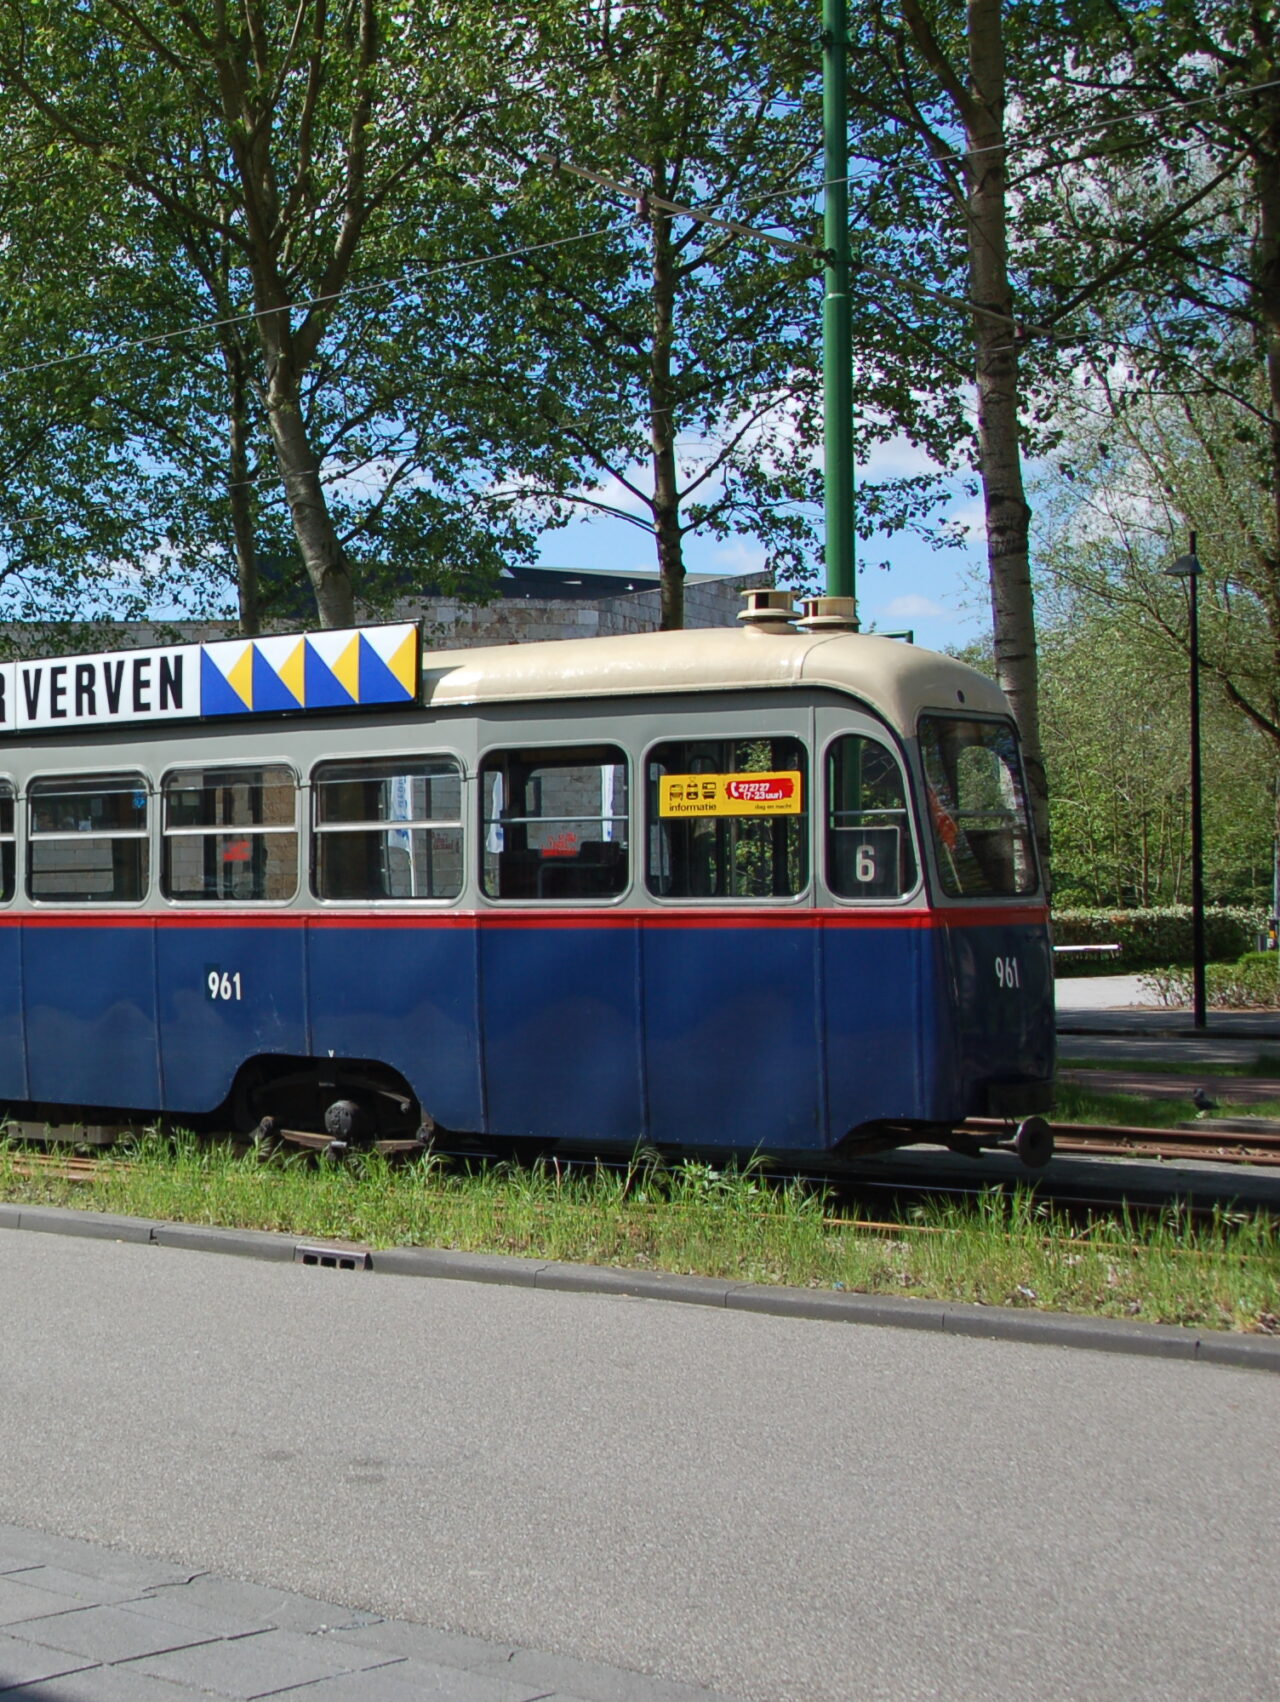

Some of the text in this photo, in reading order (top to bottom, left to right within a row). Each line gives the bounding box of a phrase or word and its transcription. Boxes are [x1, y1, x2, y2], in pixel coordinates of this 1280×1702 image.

[23, 654, 184, 720] VERVEN
[669, 803, 716, 812] informatie
[856, 845, 875, 882] 6
[208, 971, 241, 1001] 961
[995, 956, 1019, 988] 961
